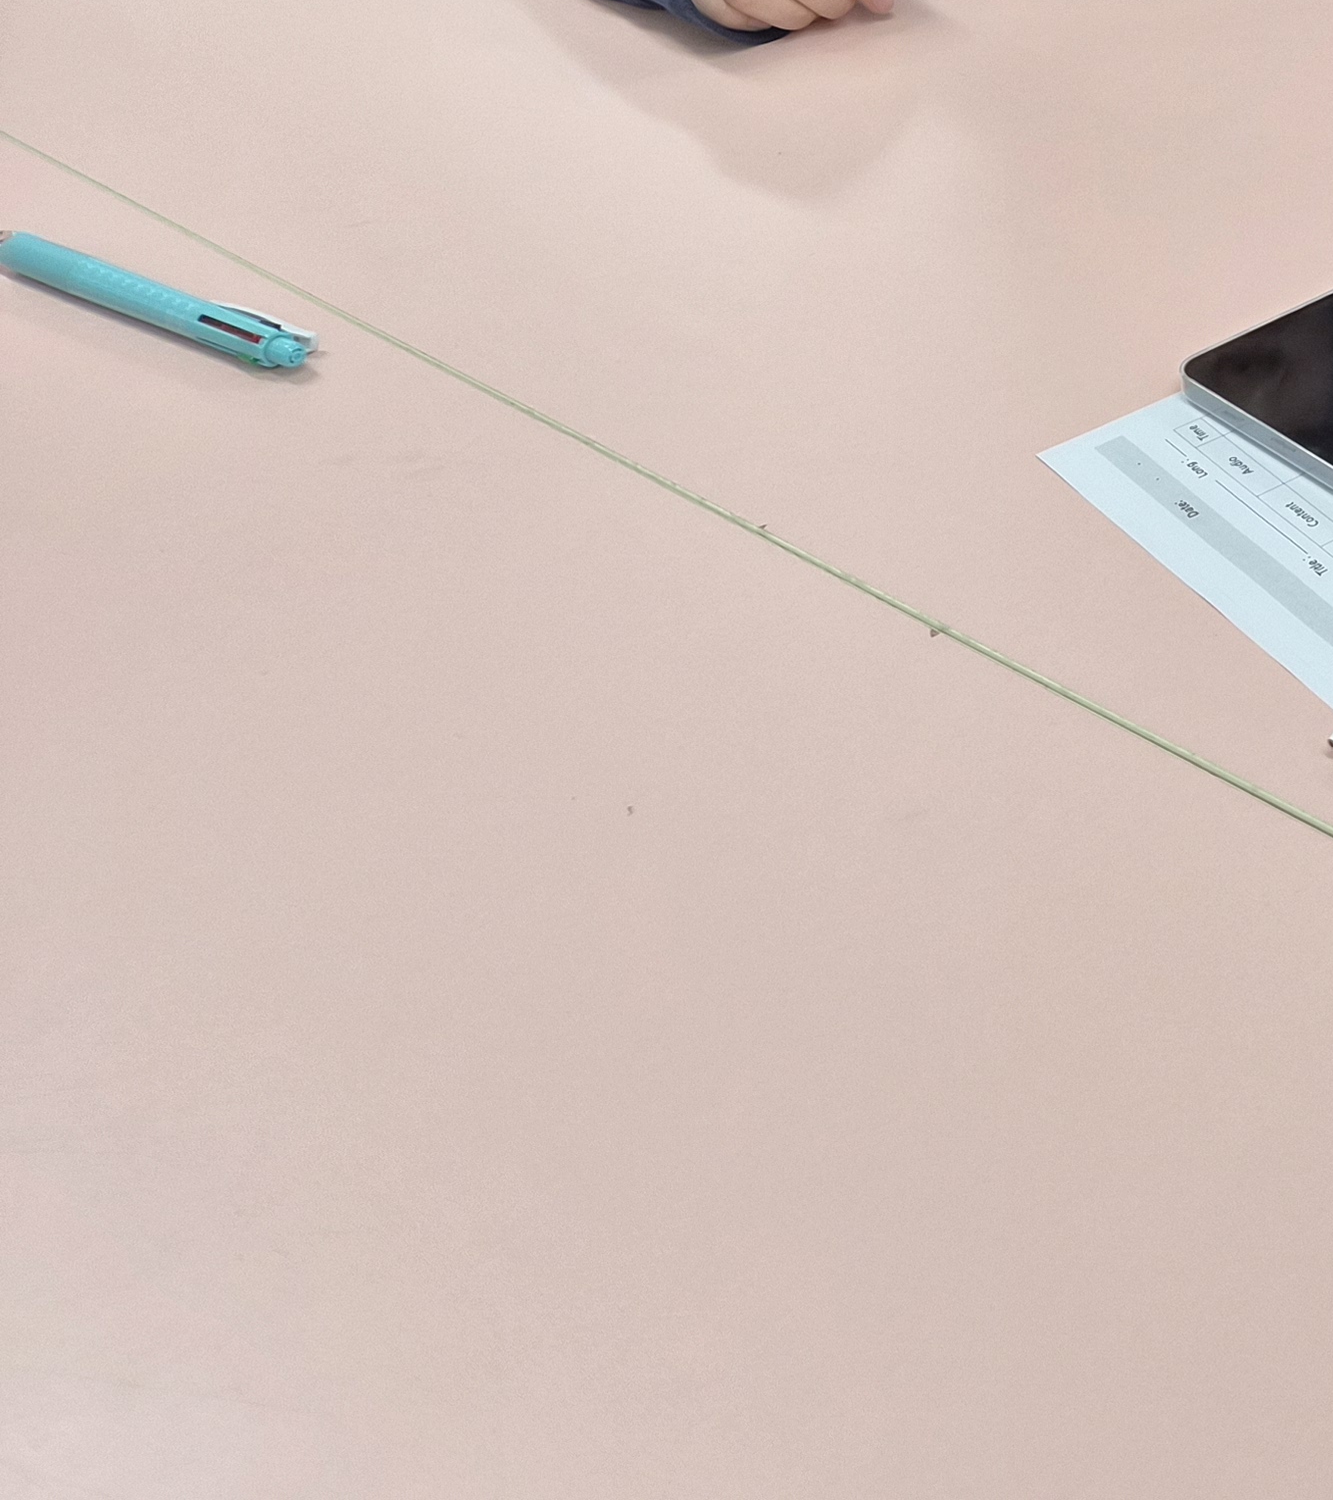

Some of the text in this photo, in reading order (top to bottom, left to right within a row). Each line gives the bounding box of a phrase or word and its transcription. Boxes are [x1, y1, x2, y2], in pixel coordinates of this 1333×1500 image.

[1189, 424, 1209, 441] Time
[1228, 456, 1254, 475] Audio
[1285, 501, 1319, 528] Content
